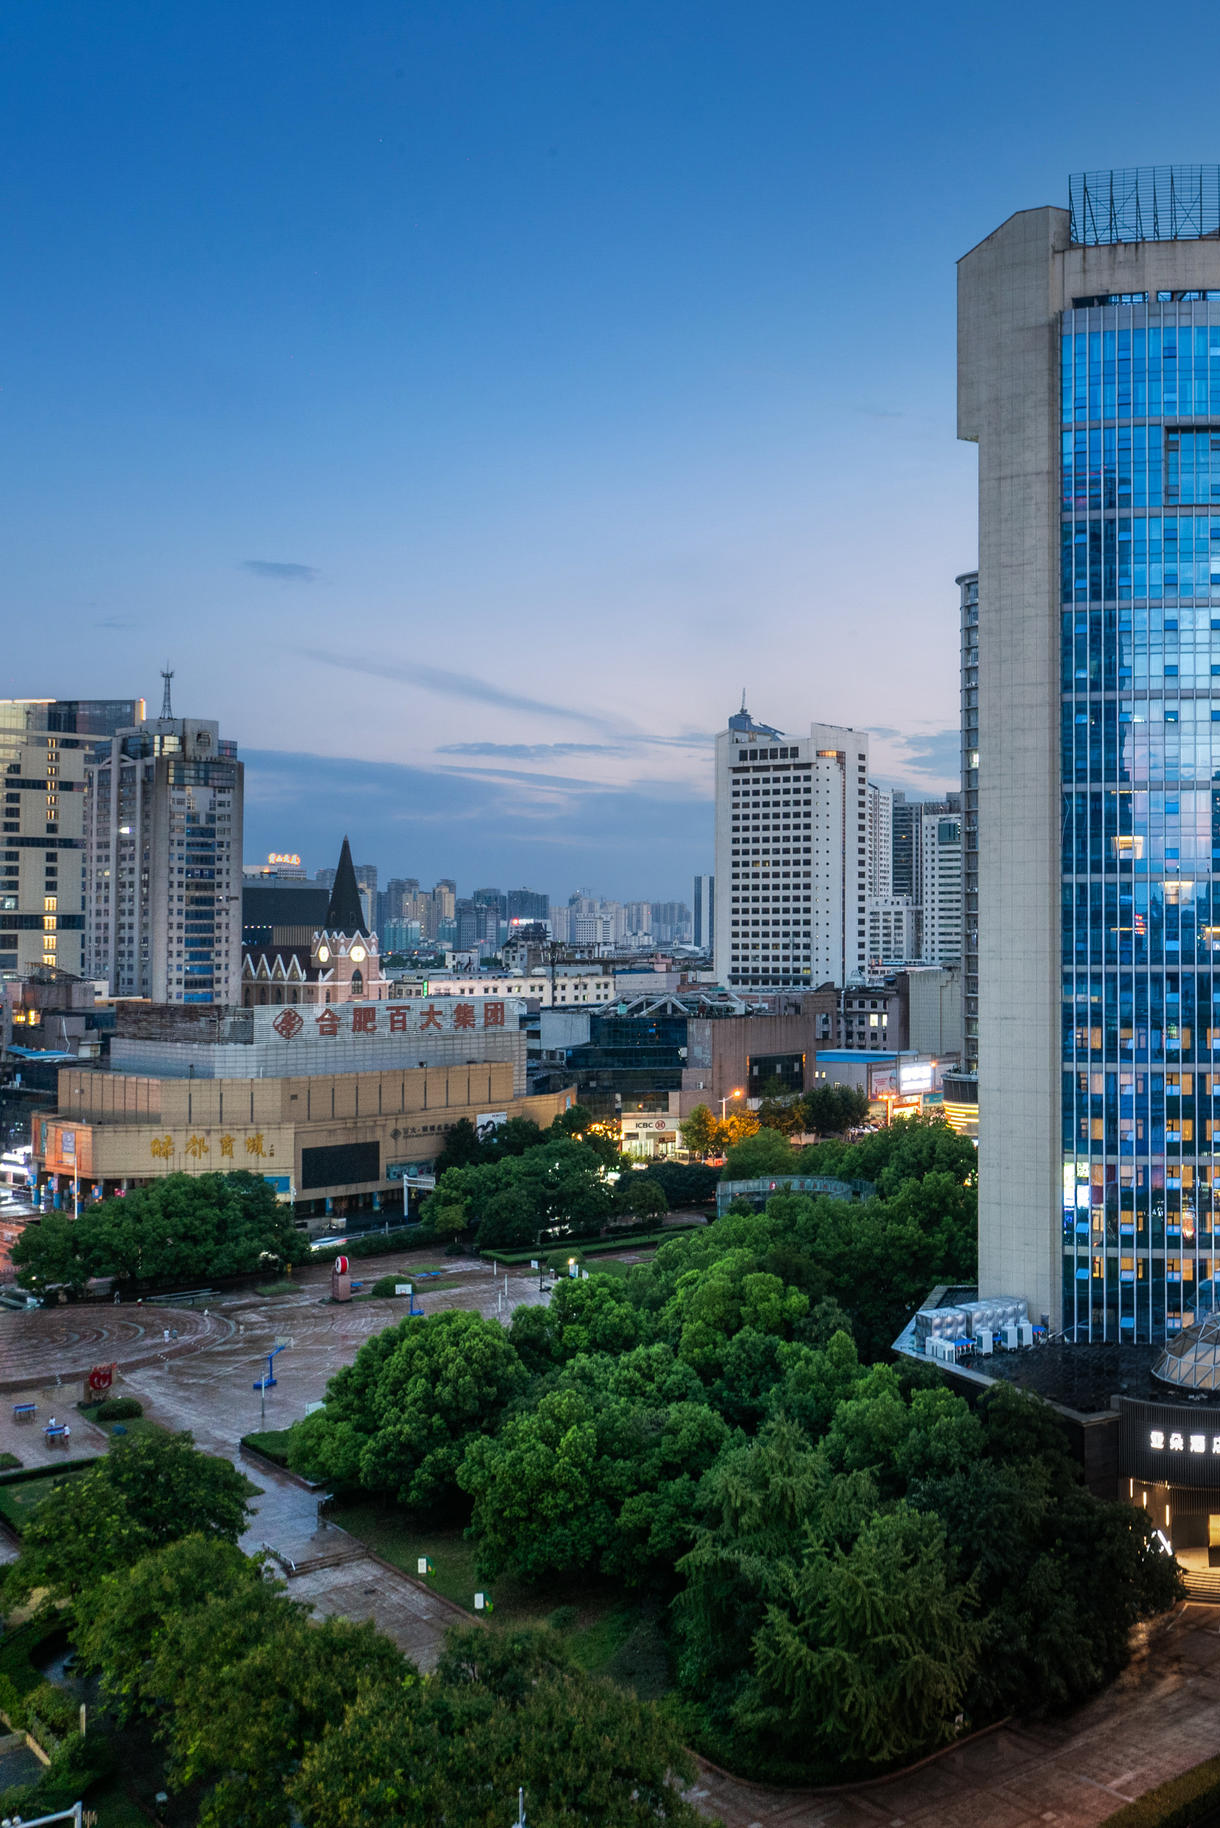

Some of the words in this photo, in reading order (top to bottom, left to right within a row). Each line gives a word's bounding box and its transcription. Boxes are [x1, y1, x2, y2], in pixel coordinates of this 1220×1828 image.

[314, 1001, 505, 1037] 合肥百大集团
